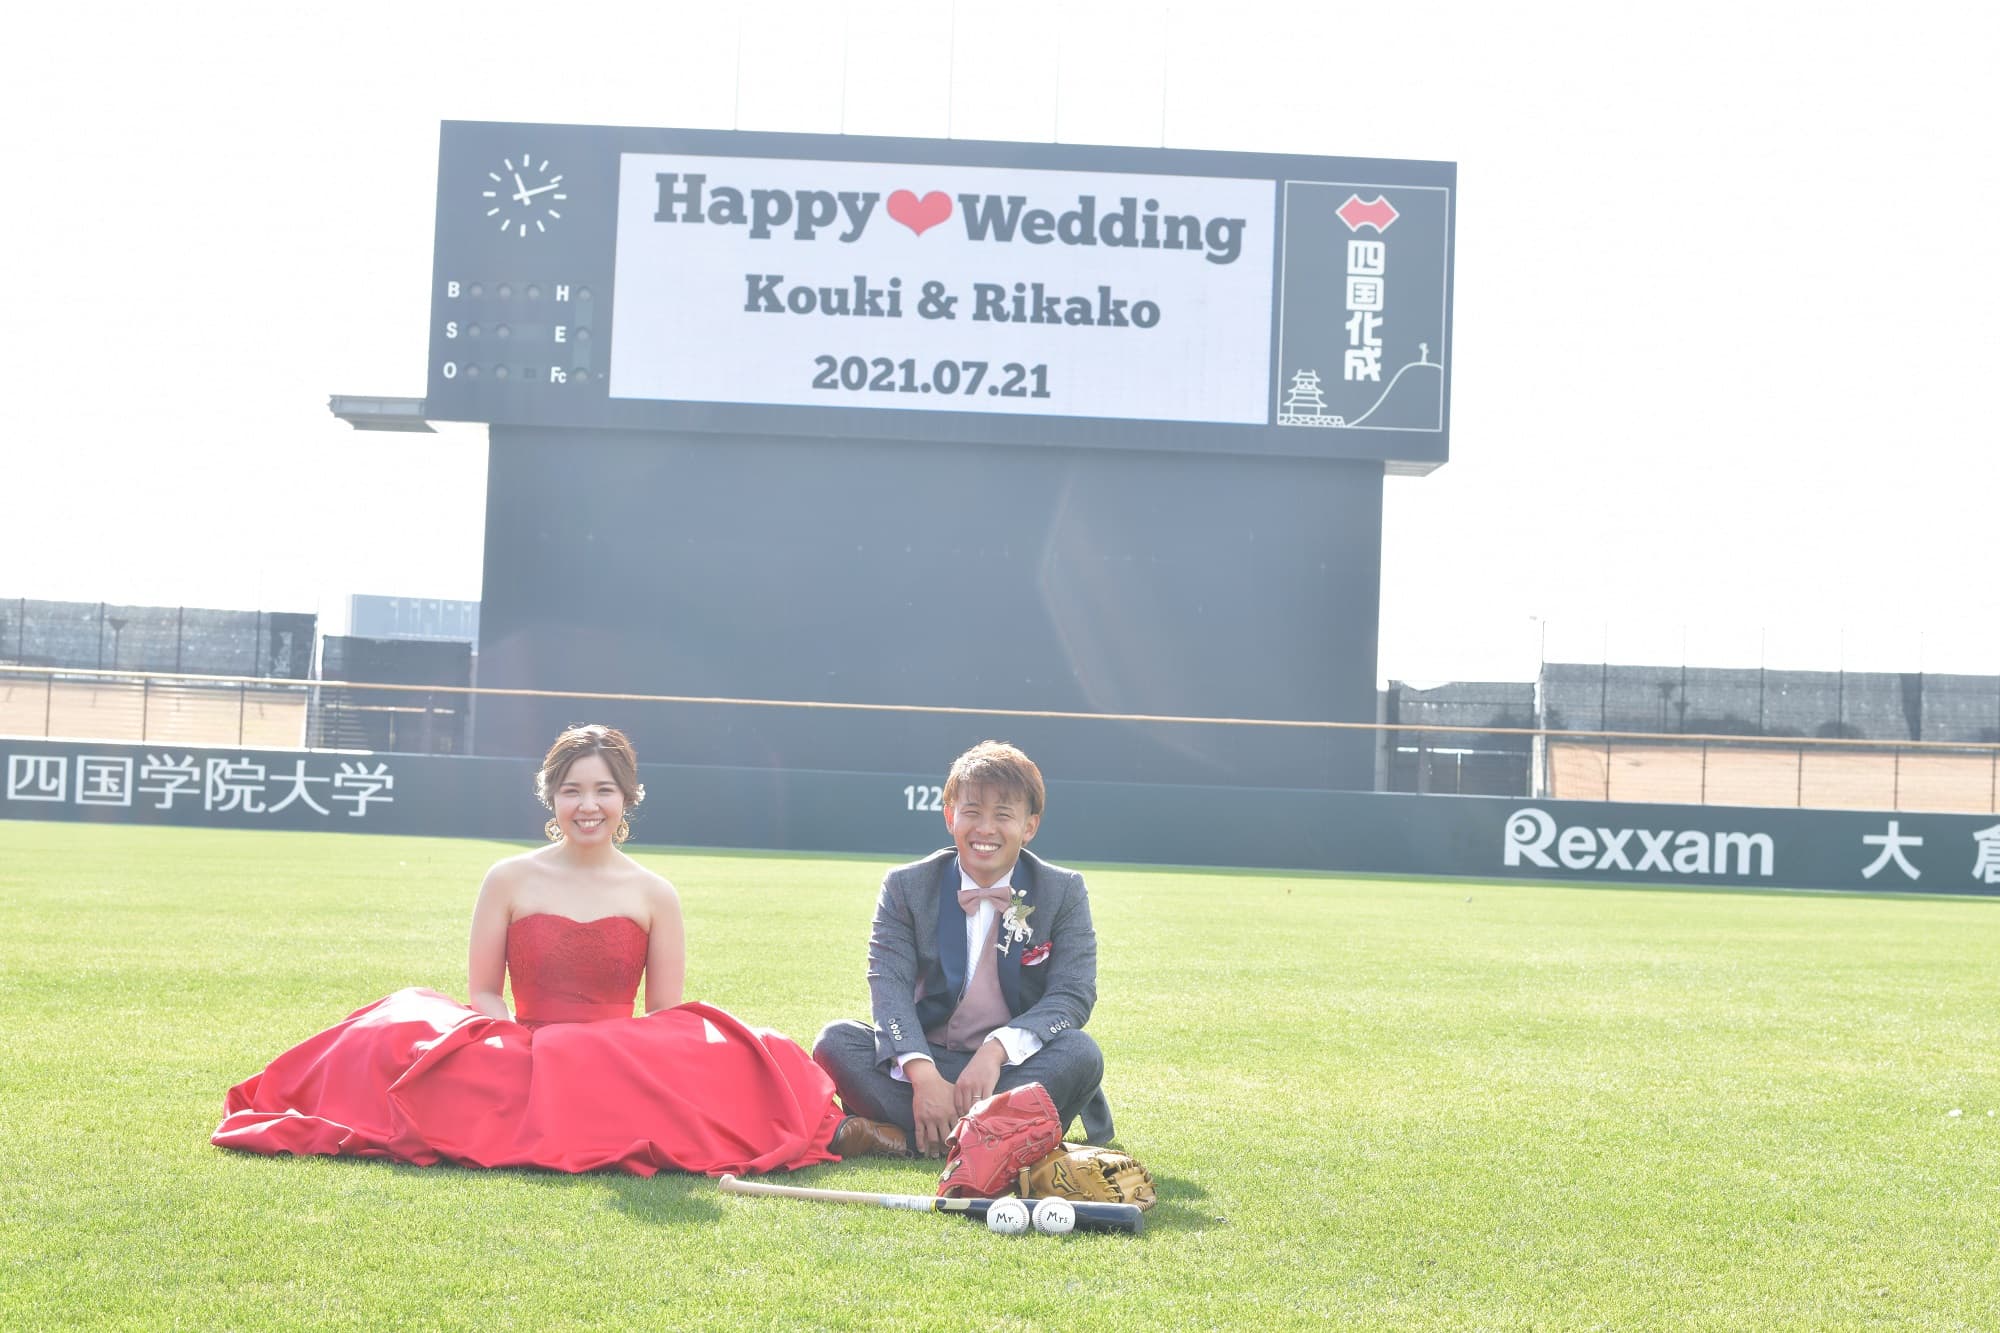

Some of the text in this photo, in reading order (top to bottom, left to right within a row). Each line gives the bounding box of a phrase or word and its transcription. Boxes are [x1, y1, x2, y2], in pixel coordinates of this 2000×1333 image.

[653, 172, 1247, 265] Happy Wedding
[447, 281, 460, 298] B
[556, 284, 570, 302] H
[744, 273, 1161, 329] Kouki & Rikako
[1343, 239, 1386, 383] 四国化成
[446, 321, 458, 339] S
[554, 325, 567, 343] E
[443, 361, 457, 379] O
[550, 366, 567, 384] Fc
[812, 354, 1051, 399] 2021.07.21
[7, 753, 395, 817] 四国学院大学
[903, 785, 943, 812] 122
[1503, 807, 1775, 876] Rexxam
[995, 1212, 1019, 1224] Mr.
